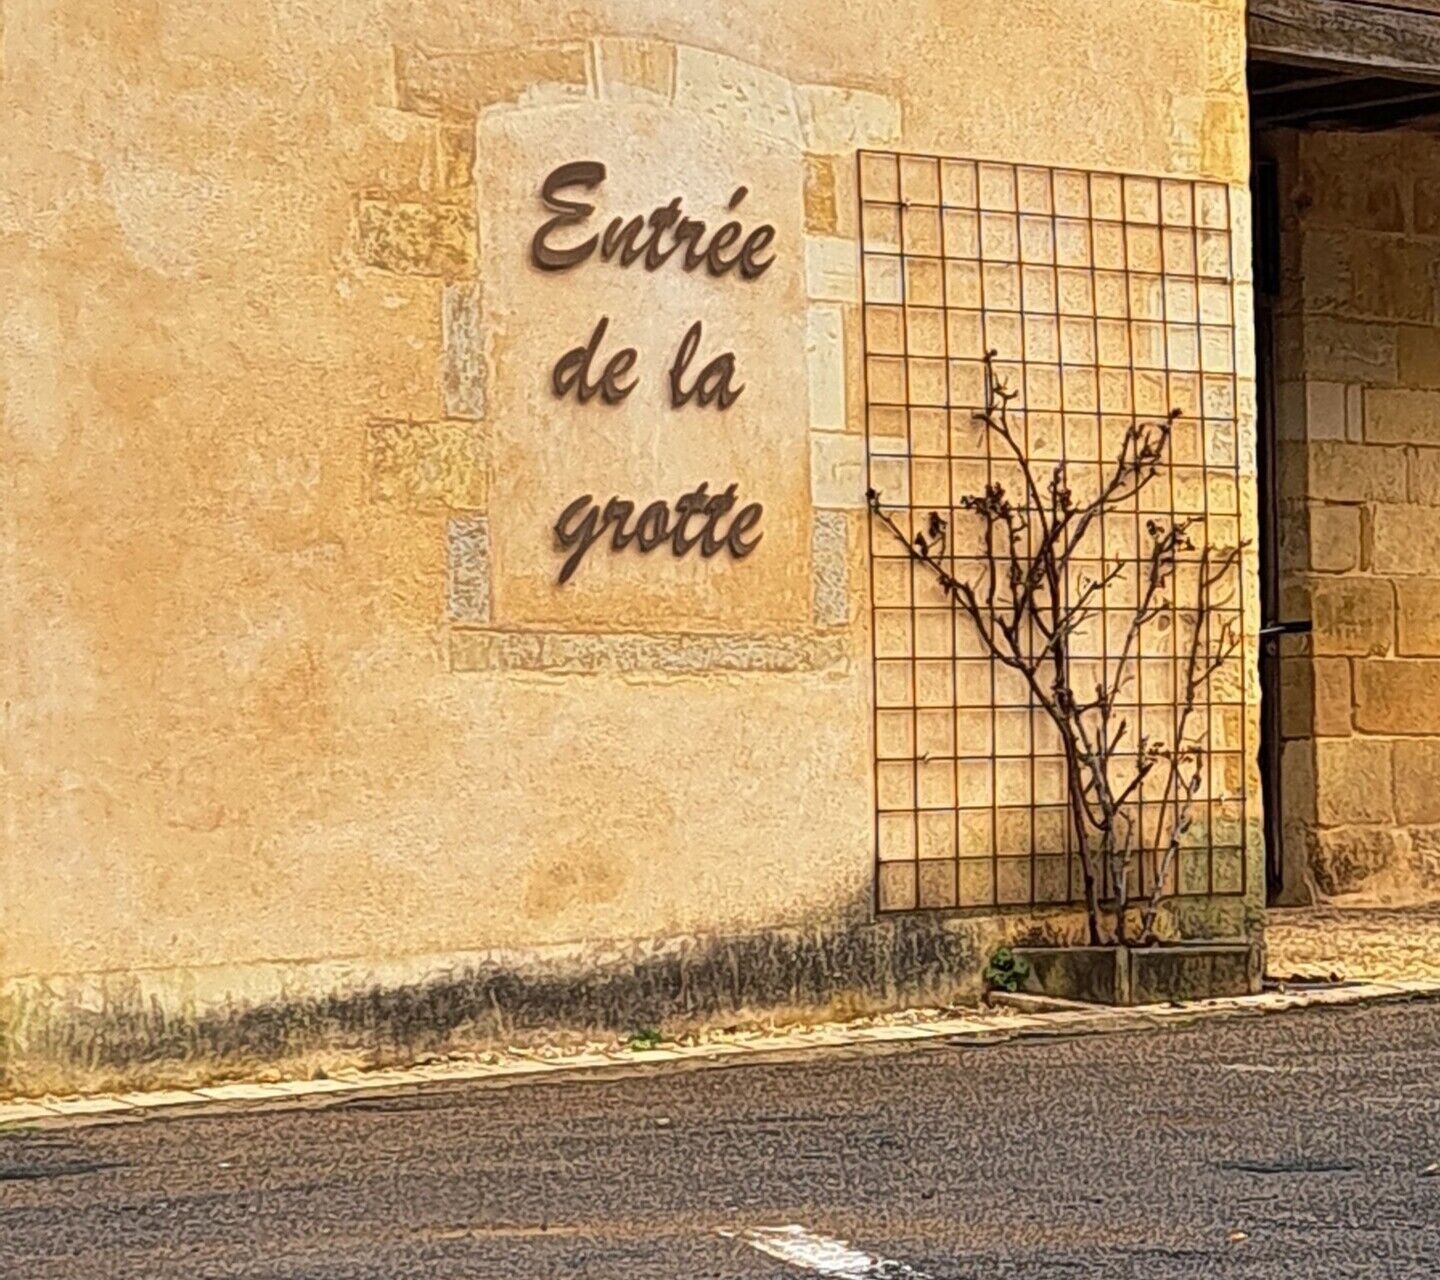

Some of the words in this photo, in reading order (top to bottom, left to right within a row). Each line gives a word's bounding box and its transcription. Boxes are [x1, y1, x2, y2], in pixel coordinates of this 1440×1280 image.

[532, 161, 776, 279] Entrée
[552, 316, 640, 406] de
[668, 320, 746, 412] la
[554, 482, 764, 585] grotte
